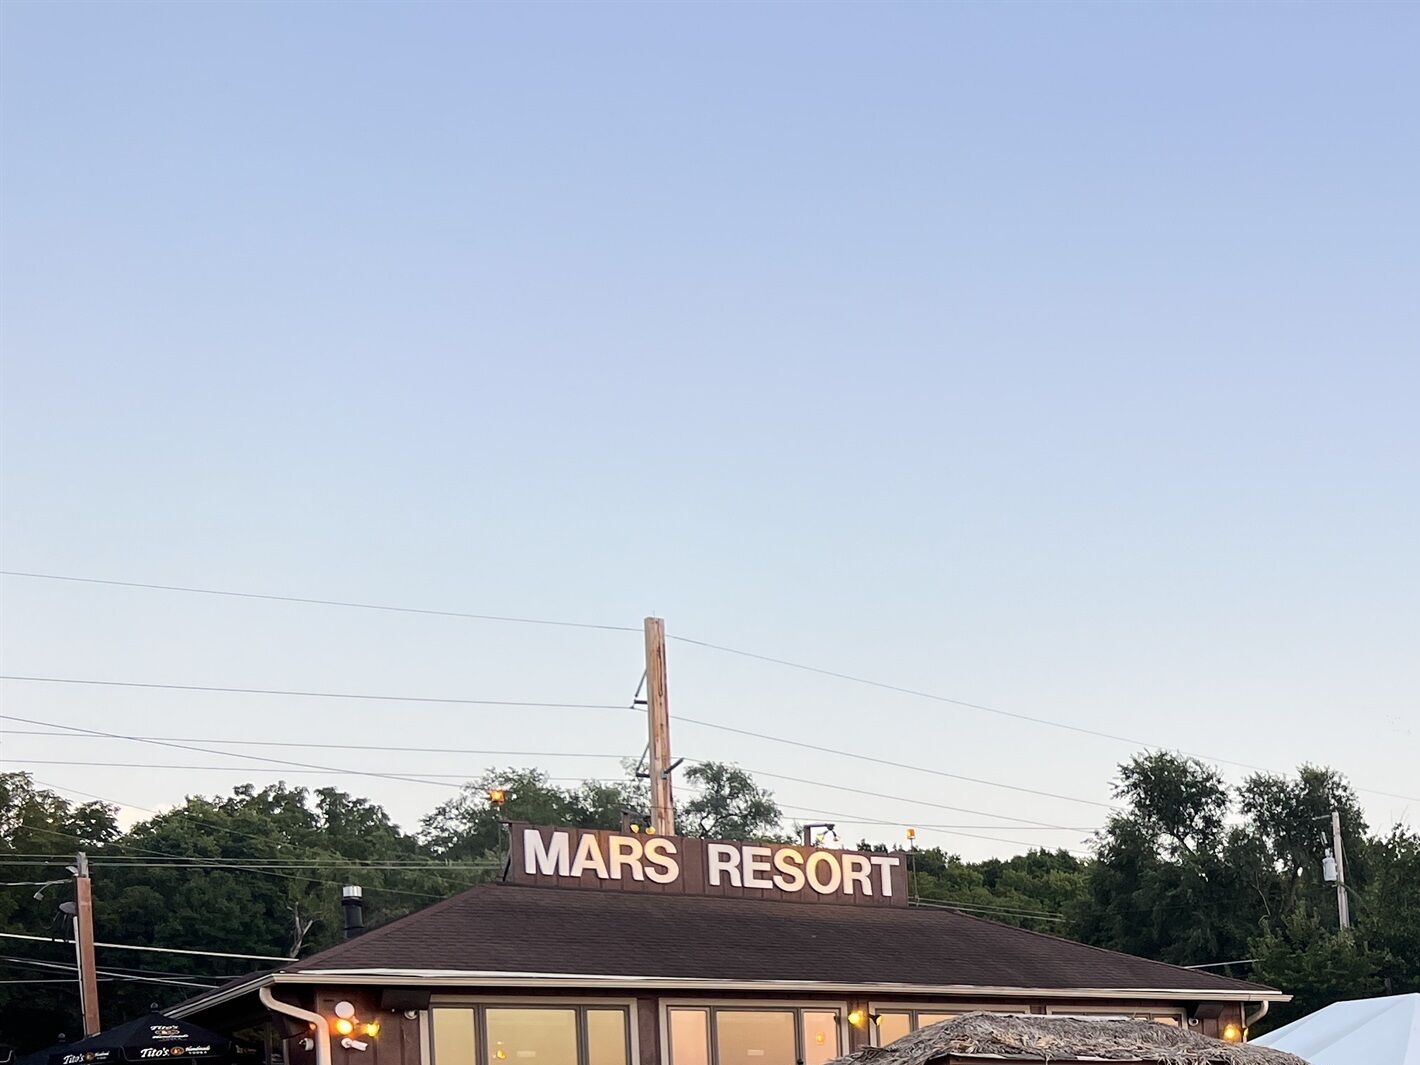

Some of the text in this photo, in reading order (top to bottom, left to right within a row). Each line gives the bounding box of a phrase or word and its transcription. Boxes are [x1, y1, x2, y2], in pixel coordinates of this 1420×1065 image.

[523, 828, 900, 898] MARS RESORT
[140, 1047, 169, 1058] Tito's
[63, 1053, 85, 1065] Tito's
